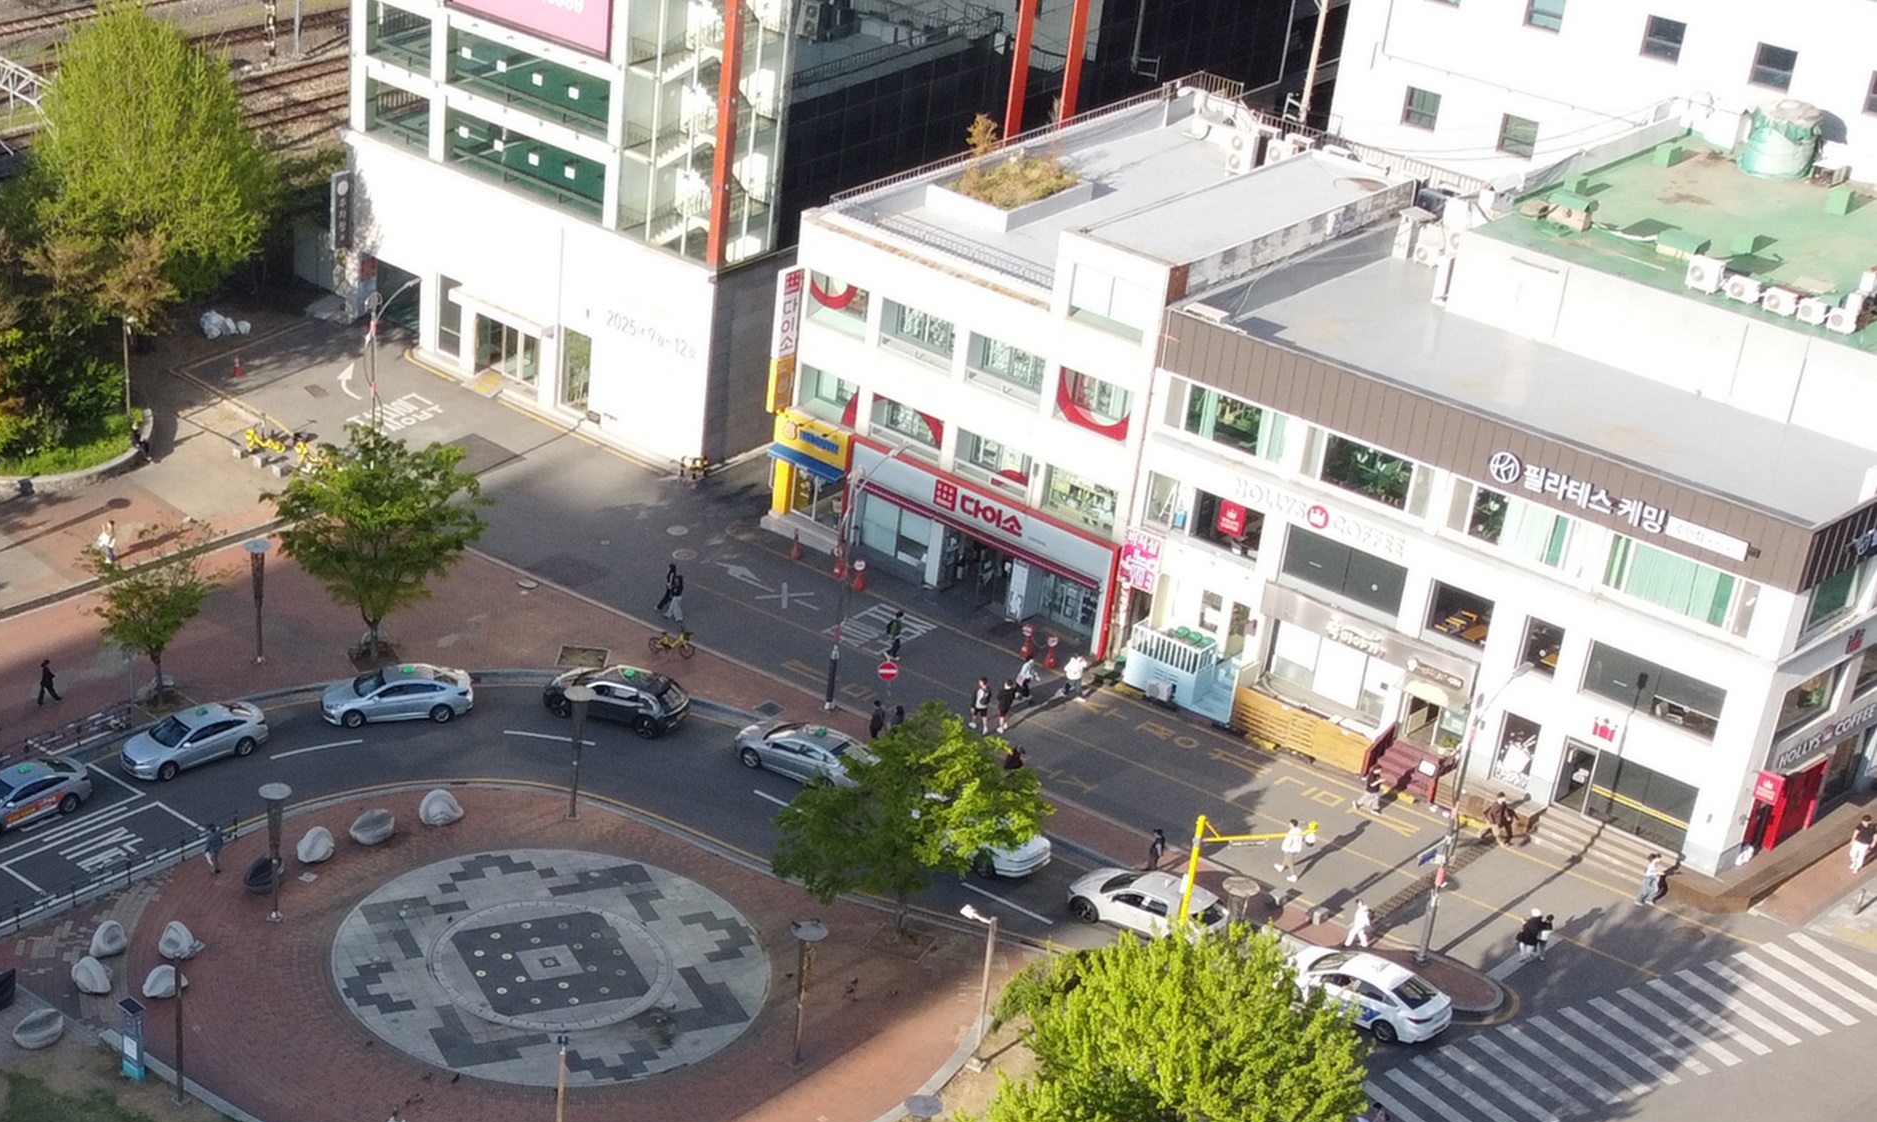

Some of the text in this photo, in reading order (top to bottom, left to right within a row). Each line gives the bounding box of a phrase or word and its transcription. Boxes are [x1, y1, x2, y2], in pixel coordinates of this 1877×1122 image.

[779, 298, 797, 353] 다이소
[960, 494, 1023, 537] 다이소
[1235, 477, 1406, 557] HOLLYS COFFEE
[1523, 463, 1614, 516] 필라테스
[1777, 703, 1877, 771] HOLLYS COFFEE
